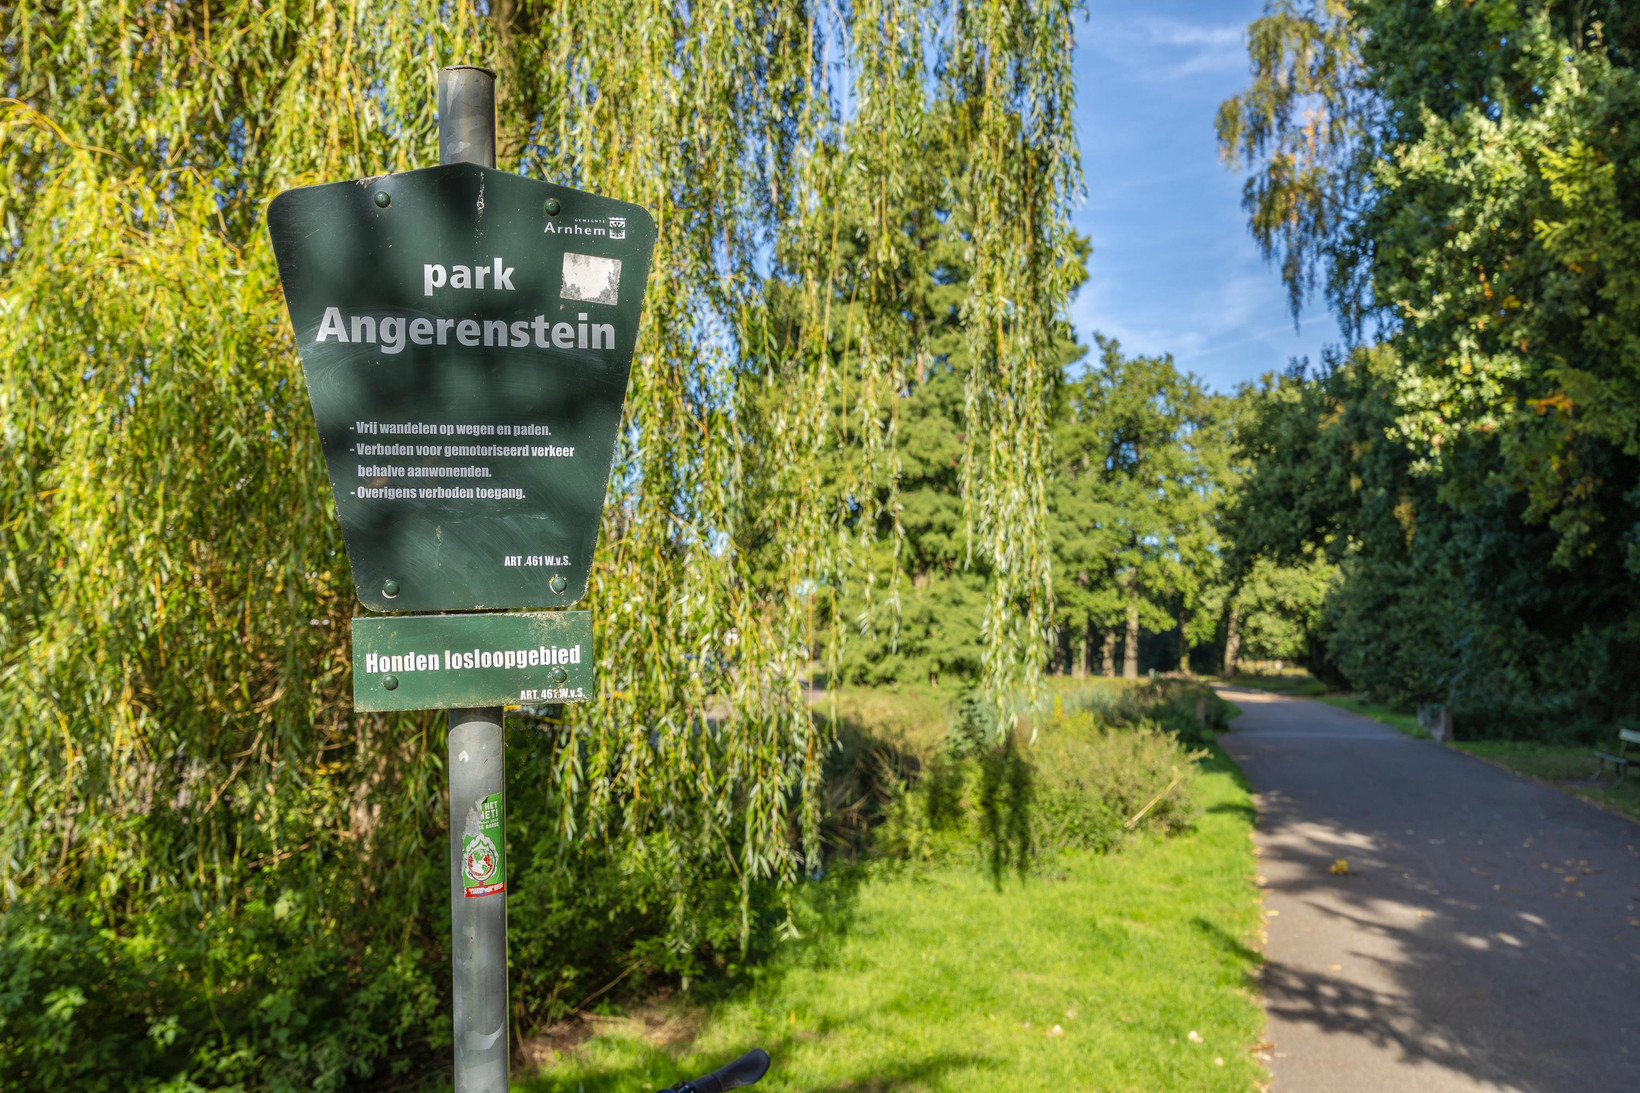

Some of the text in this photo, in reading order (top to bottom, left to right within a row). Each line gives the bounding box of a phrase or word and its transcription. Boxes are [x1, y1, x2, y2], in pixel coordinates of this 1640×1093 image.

[544, 222, 605, 235] Arnhem
[423, 258, 515, 296] park
[316, 306, 615, 354] Angerenstein
[356, 421, 377, 435] Vrij
[380, 422, 437, 435] wandelen
[440, 424, 454, 436] op
[456, 424, 495, 436] wegen
[497, 424, 511, 435] en
[514, 424, 551, 436] paden.
[357, 443, 414, 456] Verboden
[416, 445, 442, 456] voor
[444, 444, 529, 457] gemotoriseerd
[531, 446, 574, 457] verkeer
[358, 465, 492, 478] behalve aanwonenden.
[357, 487, 417, 499] Overigens
[419, 487, 473, 498] verboden
[476, 487, 525, 499] toegang.
[545, 556, 571, 566] W.v.S.
[366, 644, 581, 673] Honden losloopgebied
[520, 690, 539, 700] ART.
